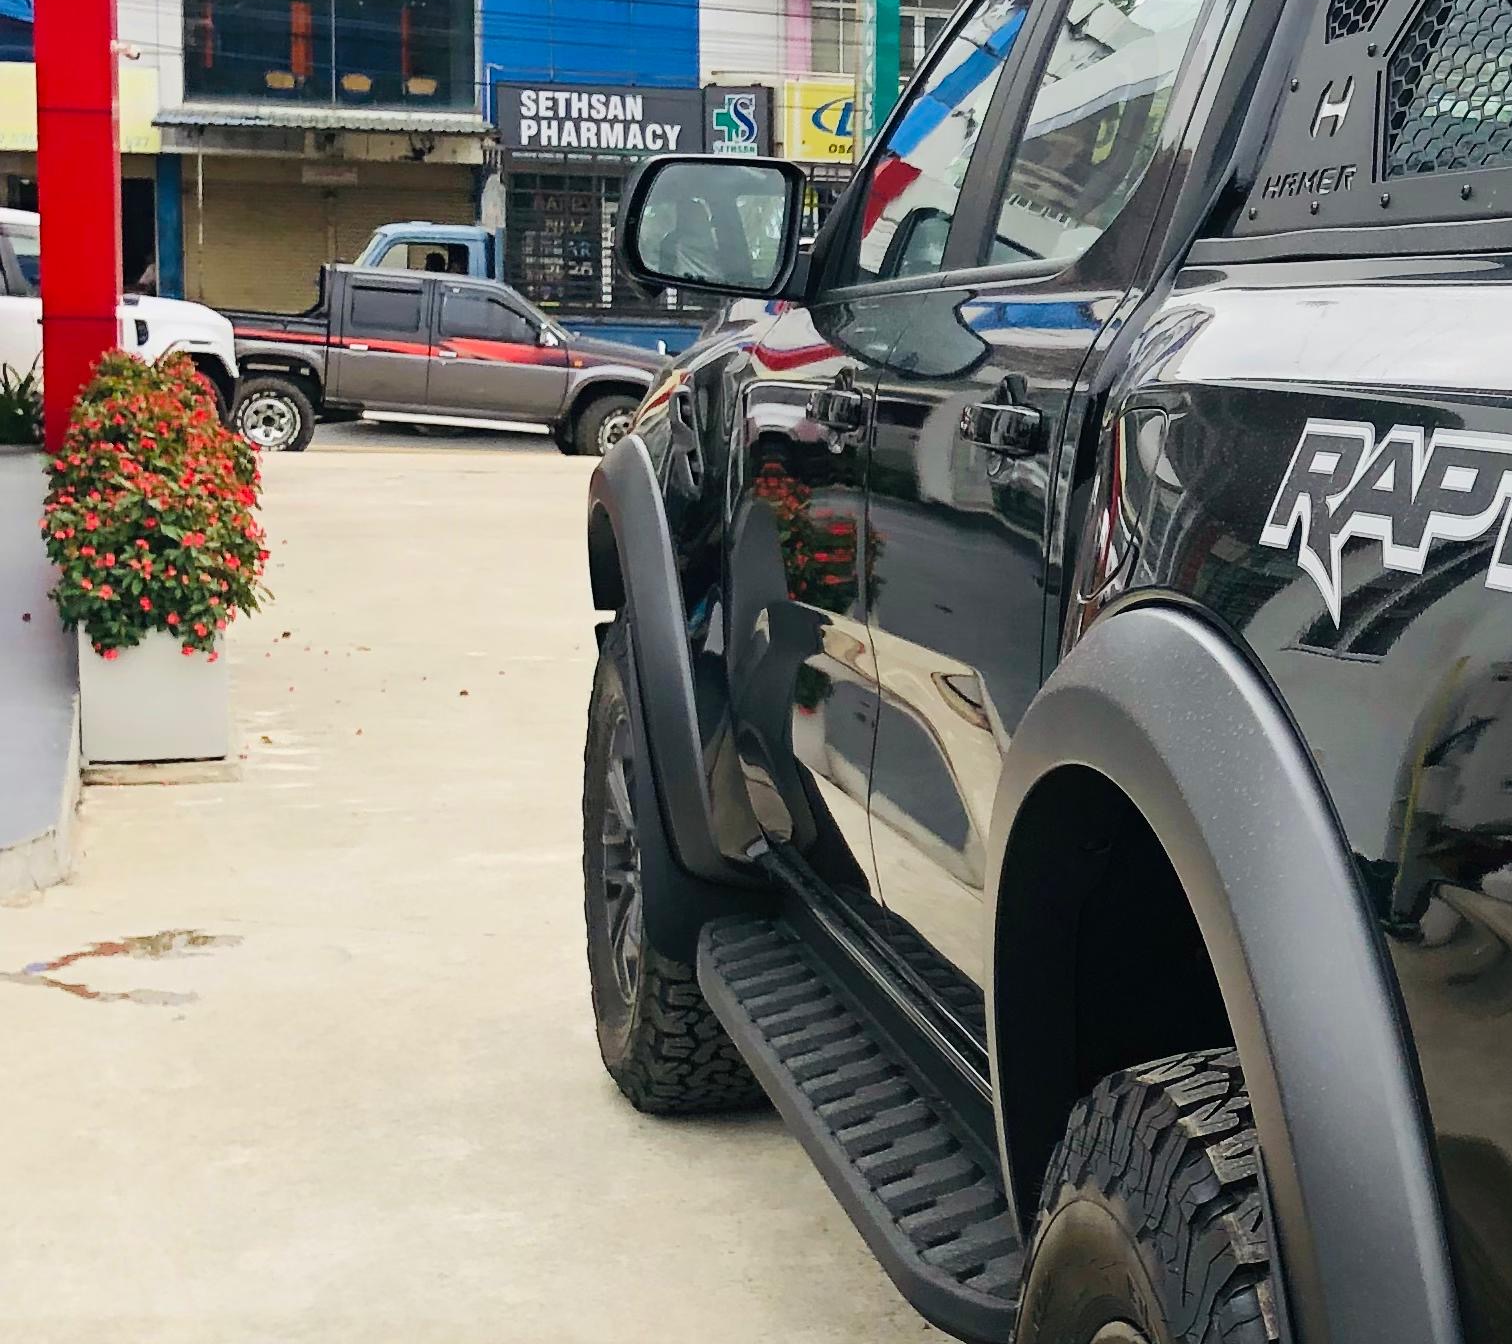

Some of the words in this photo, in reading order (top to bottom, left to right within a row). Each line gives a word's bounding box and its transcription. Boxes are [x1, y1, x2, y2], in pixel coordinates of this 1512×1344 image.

[520, 90, 643, 121] SETHSAN
[520, 119, 682, 151] PHARMACY
[1261, 163, 1357, 199] HAMER
